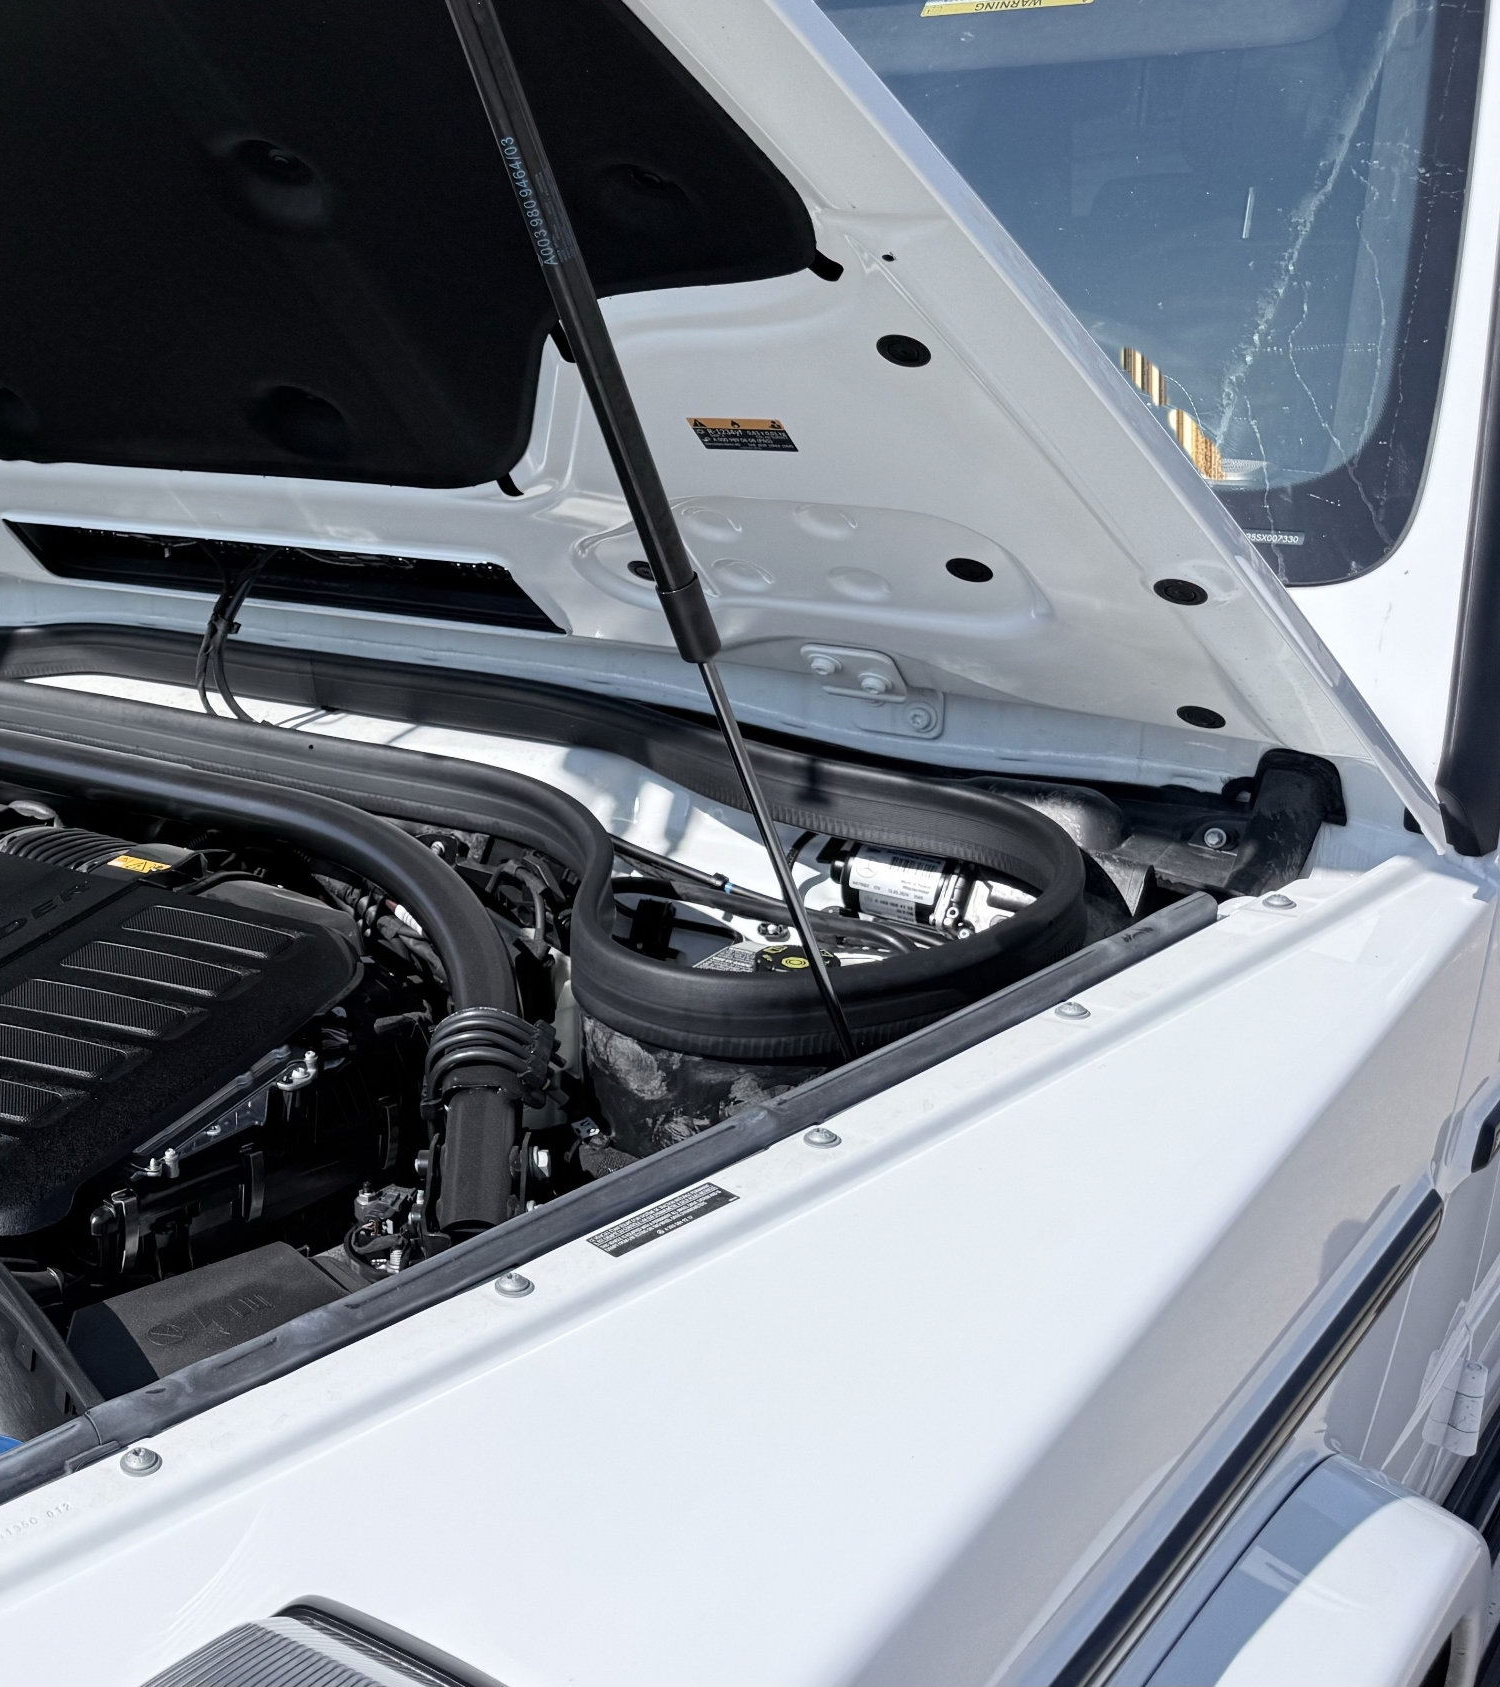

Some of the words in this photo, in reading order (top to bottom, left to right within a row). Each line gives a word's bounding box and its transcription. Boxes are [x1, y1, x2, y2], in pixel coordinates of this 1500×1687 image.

[975, 0, 1042, 11] WARNING
[501, 136, 532, 197] 9464/03
[523, 200, 543, 227] 980
[534, 229, 558, 265] A003
